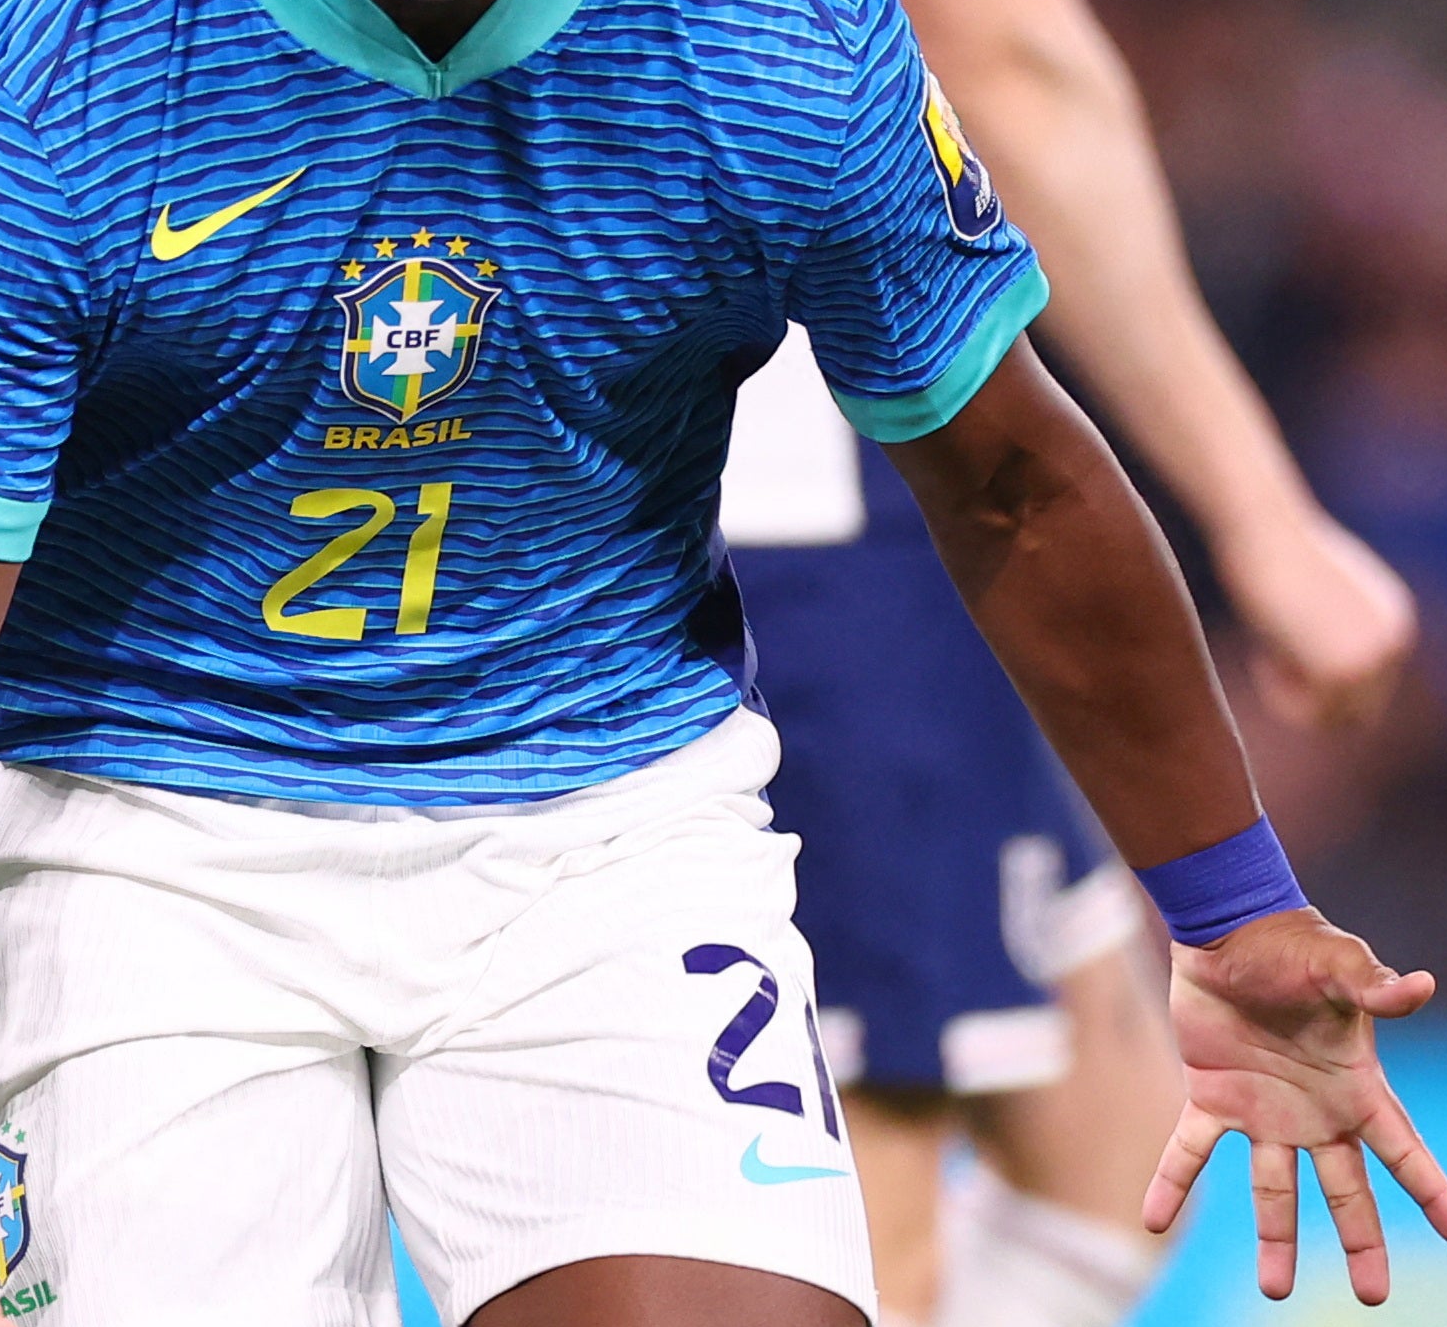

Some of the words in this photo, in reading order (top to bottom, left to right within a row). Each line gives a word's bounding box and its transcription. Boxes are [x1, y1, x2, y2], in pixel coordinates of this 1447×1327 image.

[386, 329, 441, 350] CBF
[322, 417, 473, 450] BRASIL
[261, 481, 453, 642] 21
[0, 1280, 58, 1319] ASIL
